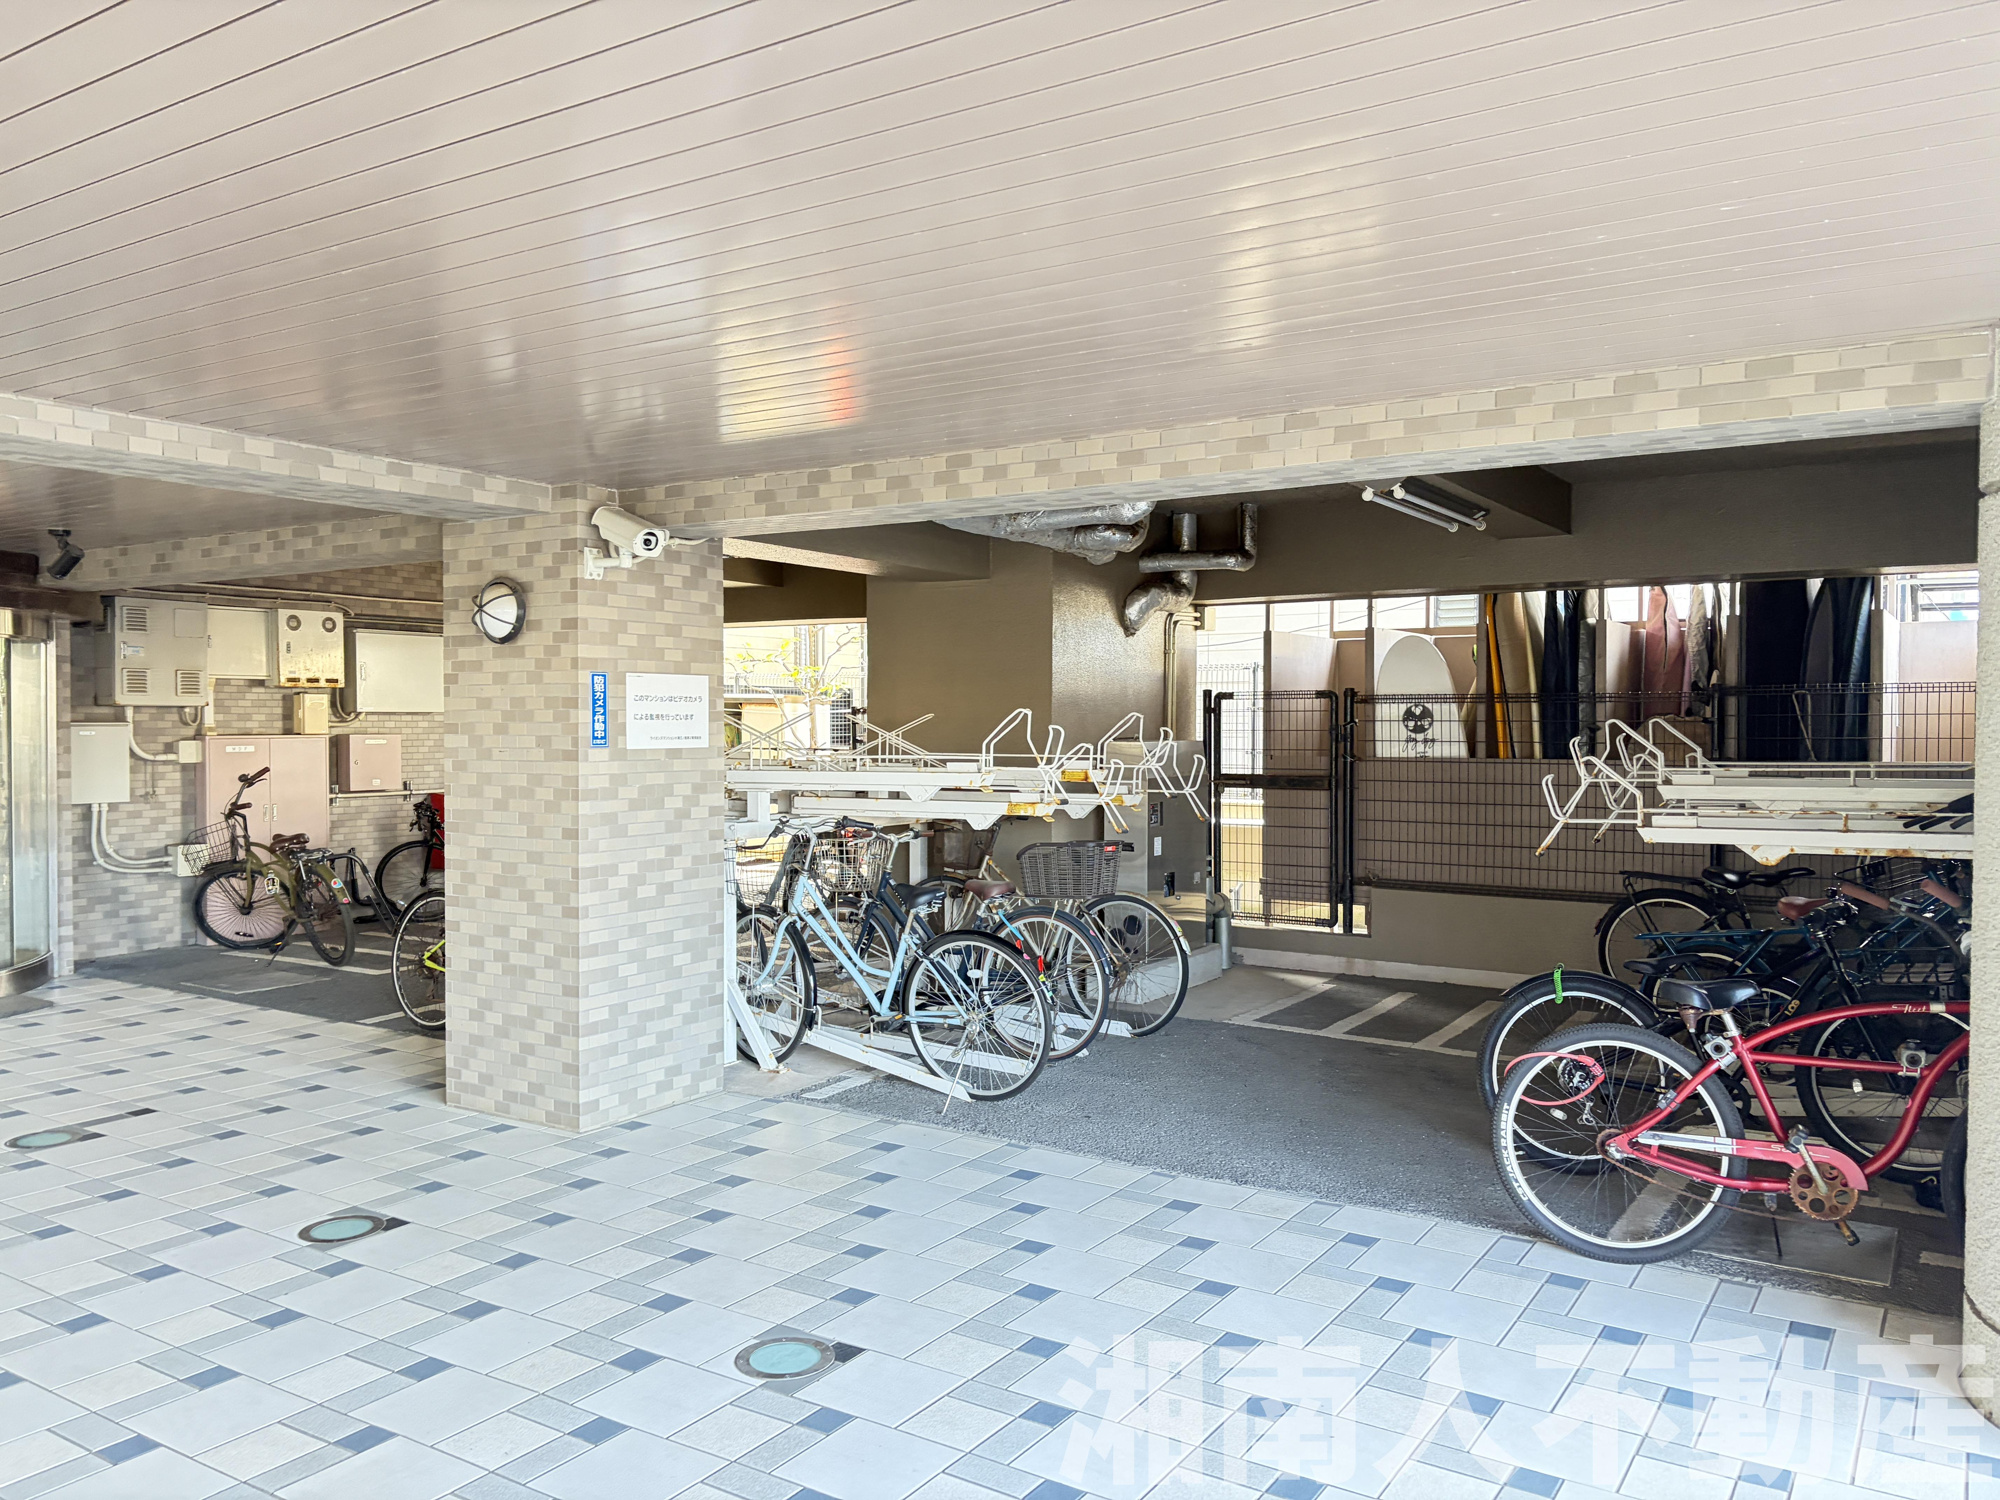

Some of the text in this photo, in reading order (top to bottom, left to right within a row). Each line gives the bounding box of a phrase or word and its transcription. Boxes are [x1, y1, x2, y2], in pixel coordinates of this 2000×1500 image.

[593, 675, 605, 739] 防犯カメラ作動中
[633, 694, 703, 703] このマンションはビデオカメラ
[633, 713, 695, 721] による監視を行っています
[1500, 1102, 1511, 1148] RABBIT
[1502, 1149, 1517, 1180] JACK
